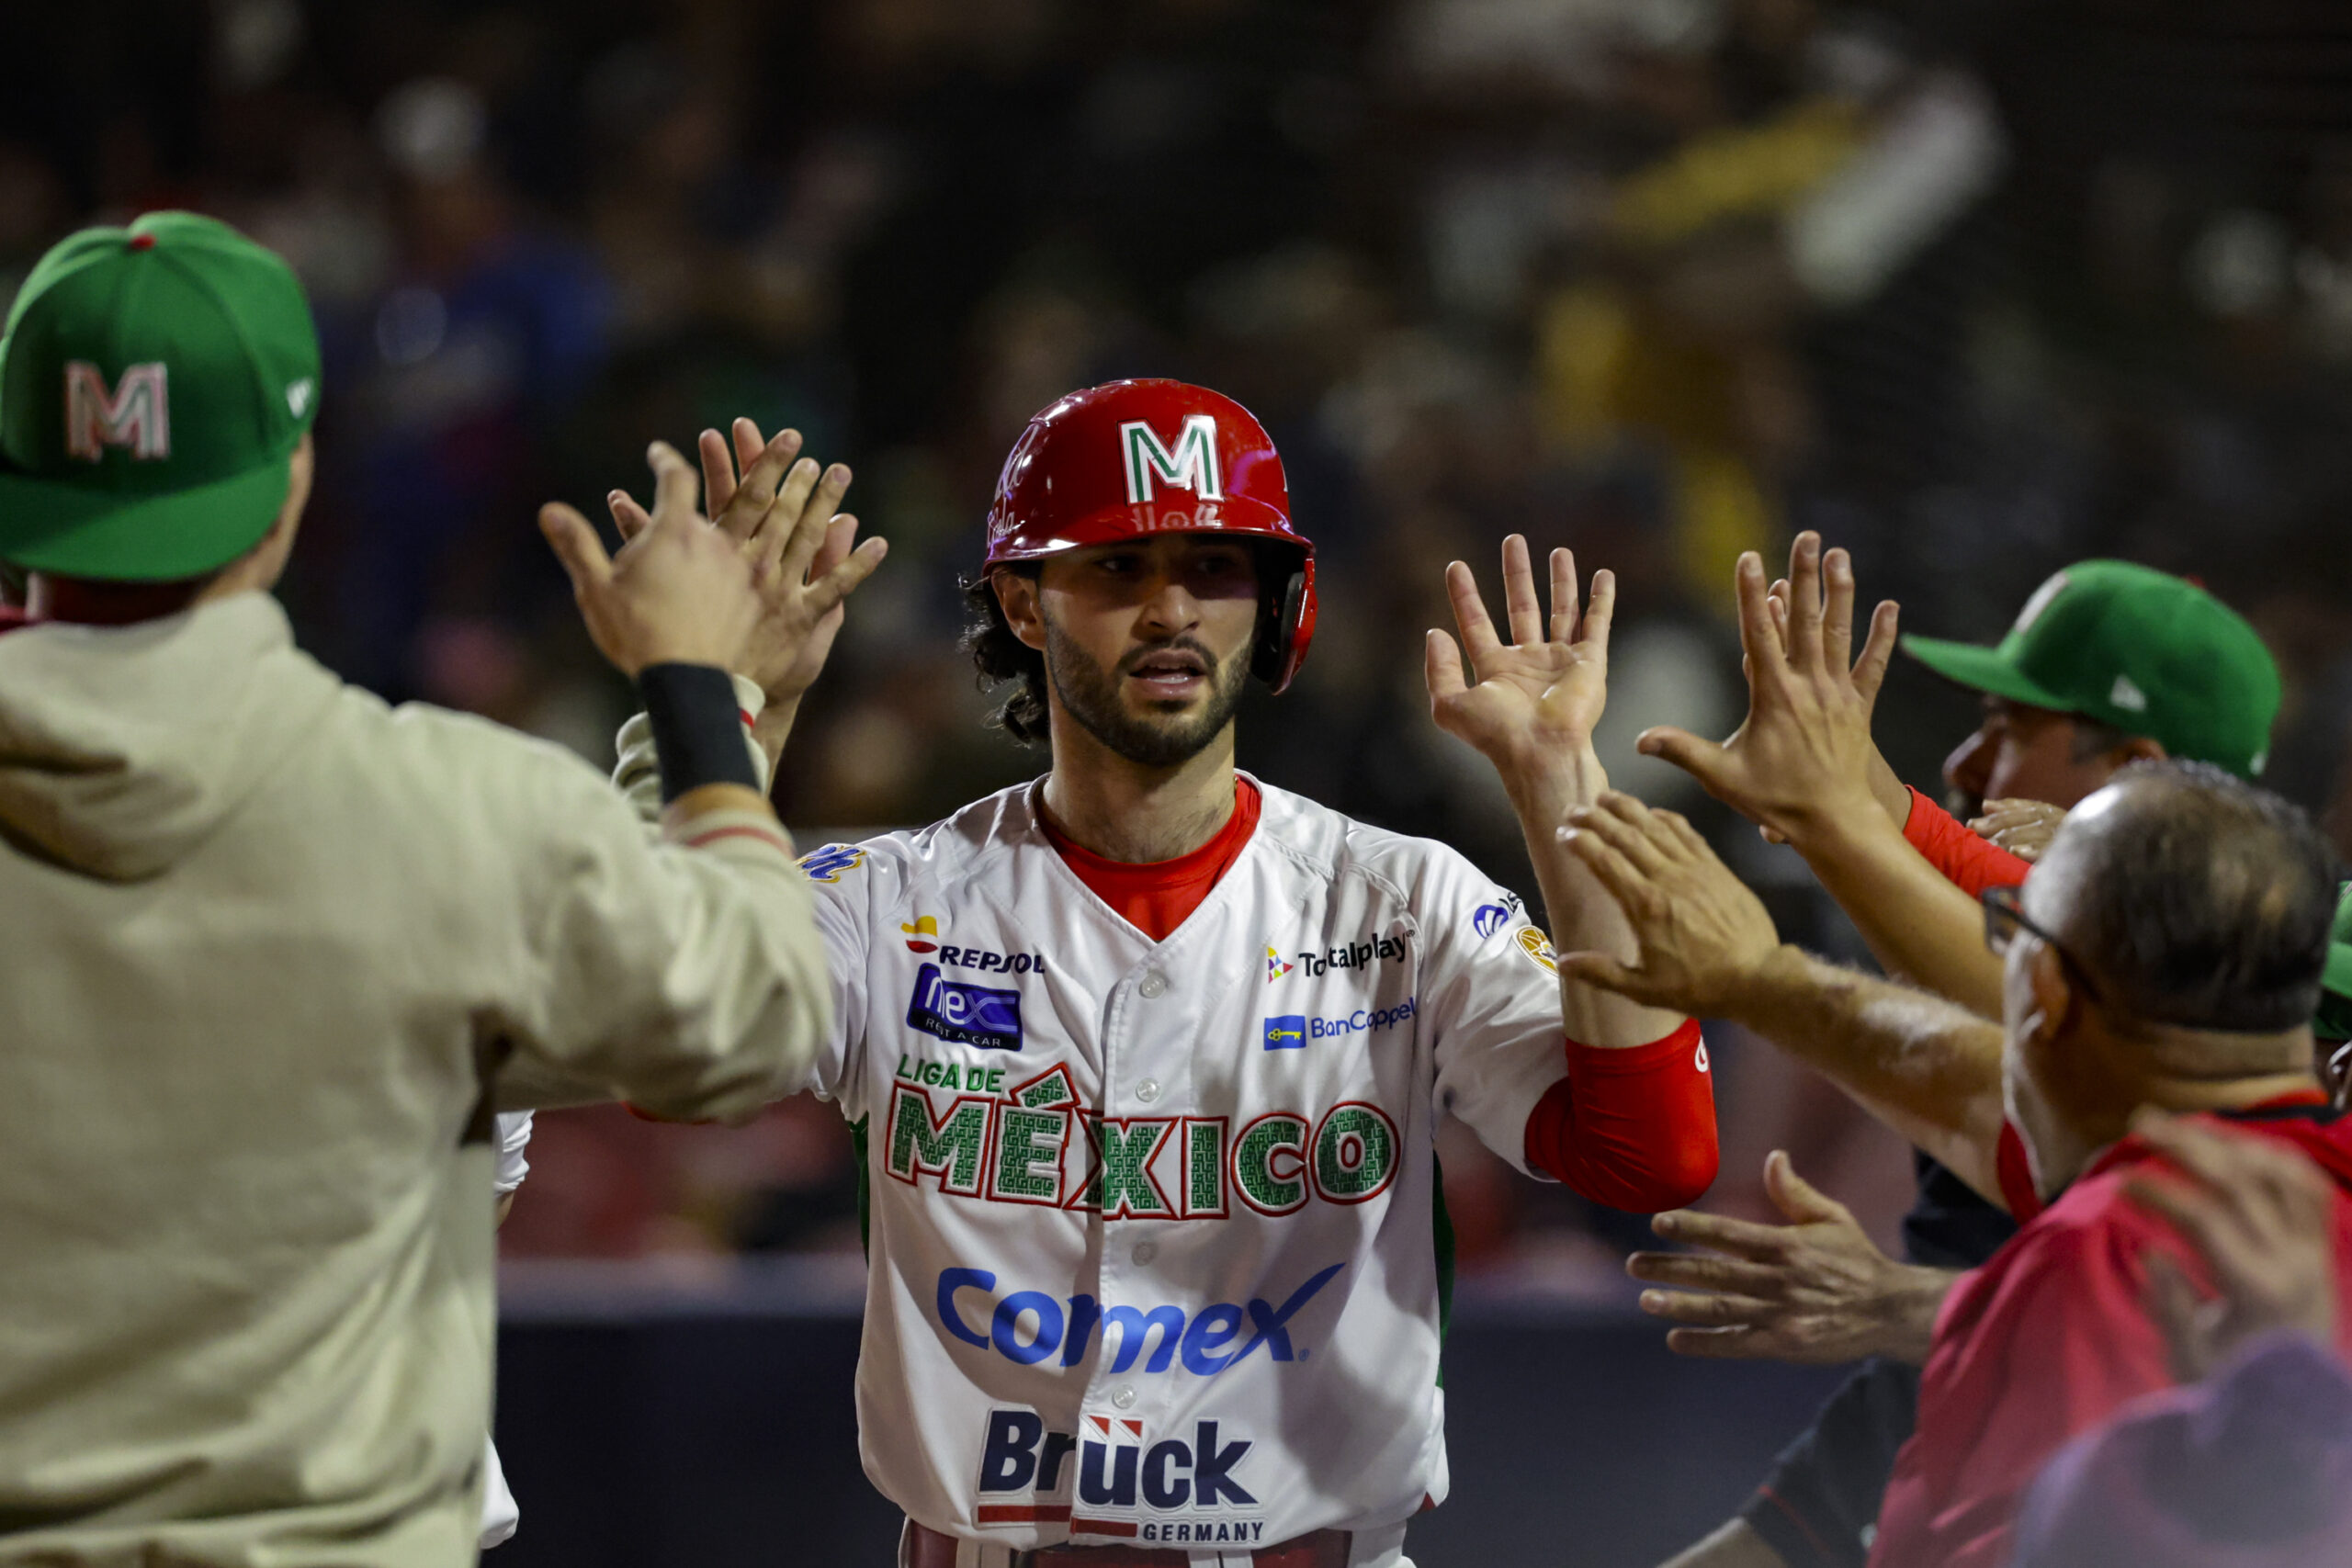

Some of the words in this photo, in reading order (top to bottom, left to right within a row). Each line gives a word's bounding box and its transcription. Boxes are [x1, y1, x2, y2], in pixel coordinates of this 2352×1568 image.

[66, 360, 171, 461] M
[1117, 414, 1224, 506] M
[939, 945, 1046, 975] REPSOL
[957, 1032, 966, 1040] A
[972, 1035, 1001, 1047] CAR
[1311, 997, 1417, 1039] BanCoppel
[897, 1054, 961, 1090] LIGA
[966, 1066, 1006, 1092] DE
[885, 1062, 1401, 1220] MÉXICO
[936, 1262, 1347, 1376] Comex
[978, 1410, 1260, 1509] Brück
[1142, 1521, 1264, 1542] GERMANY
